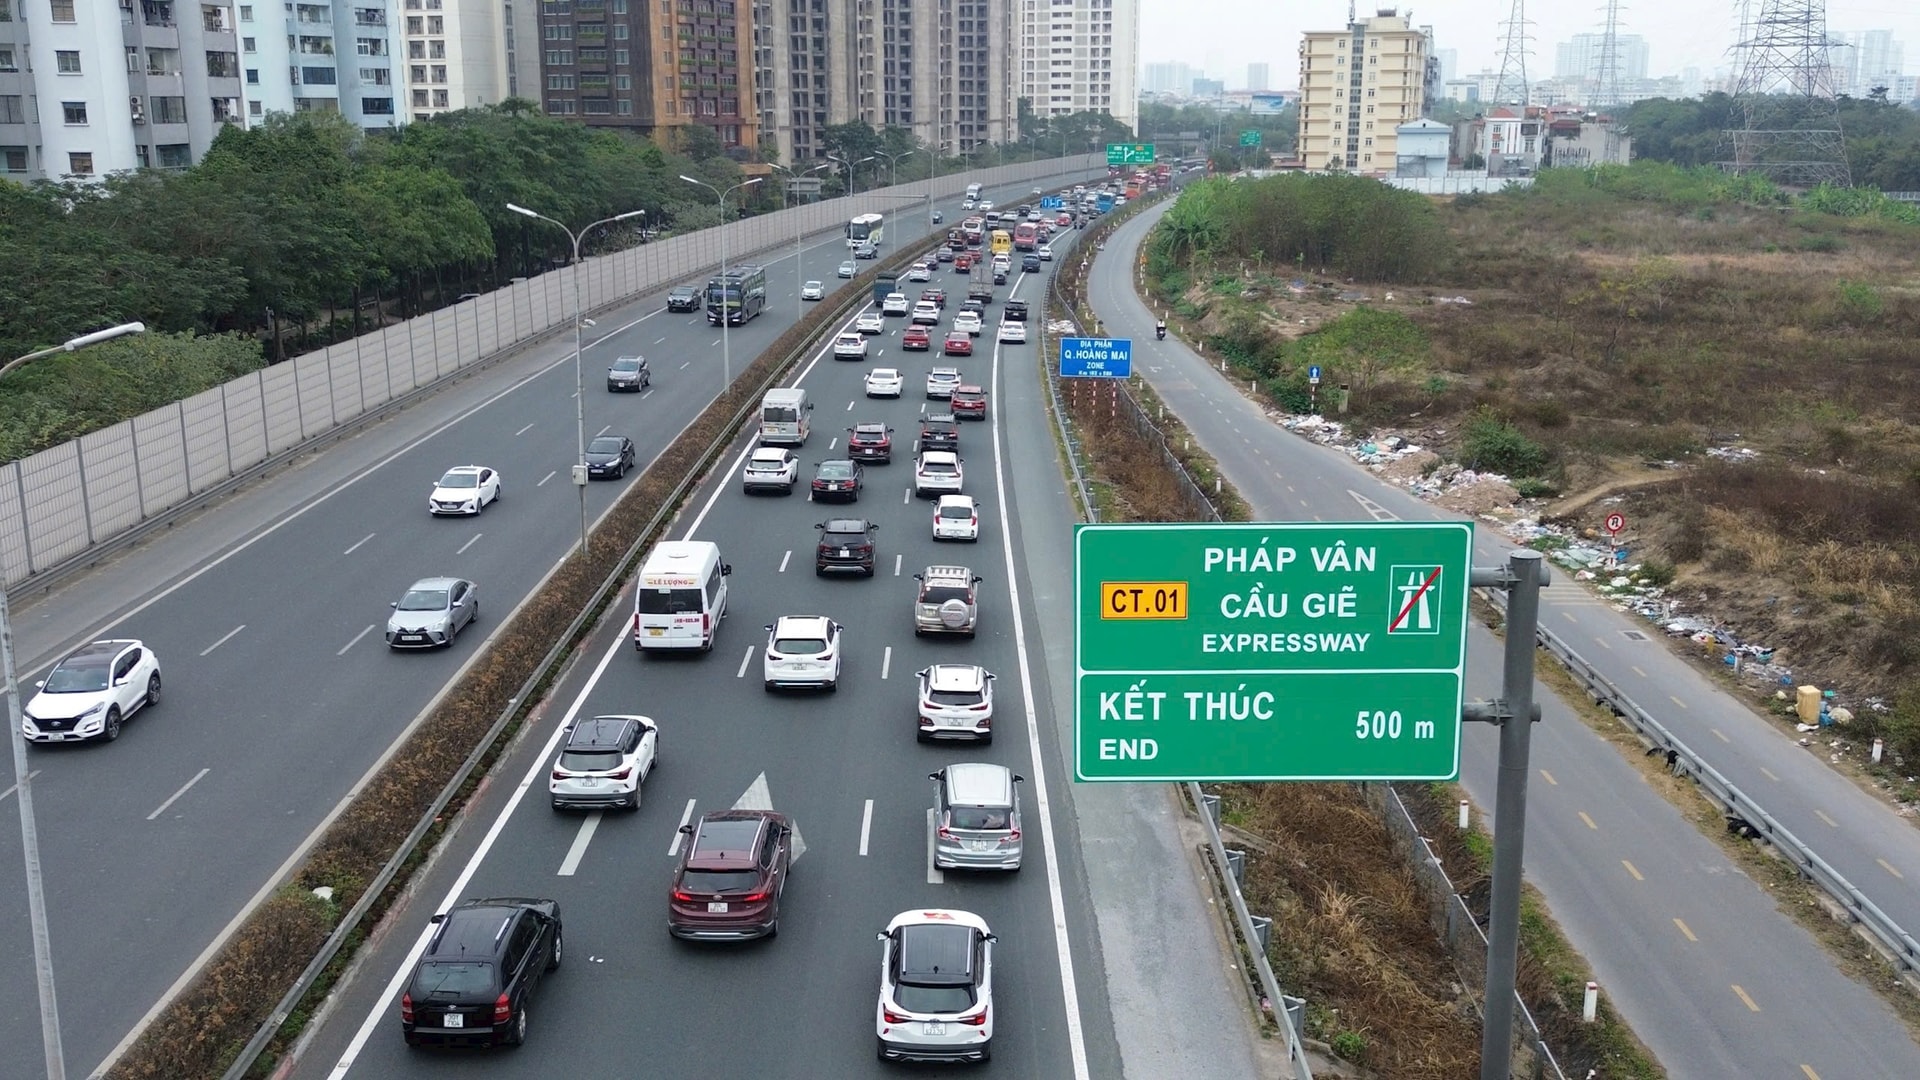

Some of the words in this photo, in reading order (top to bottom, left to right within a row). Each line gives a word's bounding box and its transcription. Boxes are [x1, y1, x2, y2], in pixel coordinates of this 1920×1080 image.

[1086, 361, 1105, 370] ZONE
[1111, 350, 1128, 360] MAI
[1204, 537, 1297, 573] PHÁP
[1310, 540, 1376, 572] VÂN
[1111, 589, 1178, 613] CT.01
[1220, 582, 1288, 618] CẦU
[1302, 586, 1357, 618] GIẼ
[1202, 633, 1371, 653] EXPRESSWAY
[1100, 680, 1167, 721] KẾT
[1184, 684, 1275, 721] THÚC
[1356, 711, 1402, 739] 500
[1415, 720, 1434, 739] m
[1099, 738, 1159, 760] END
